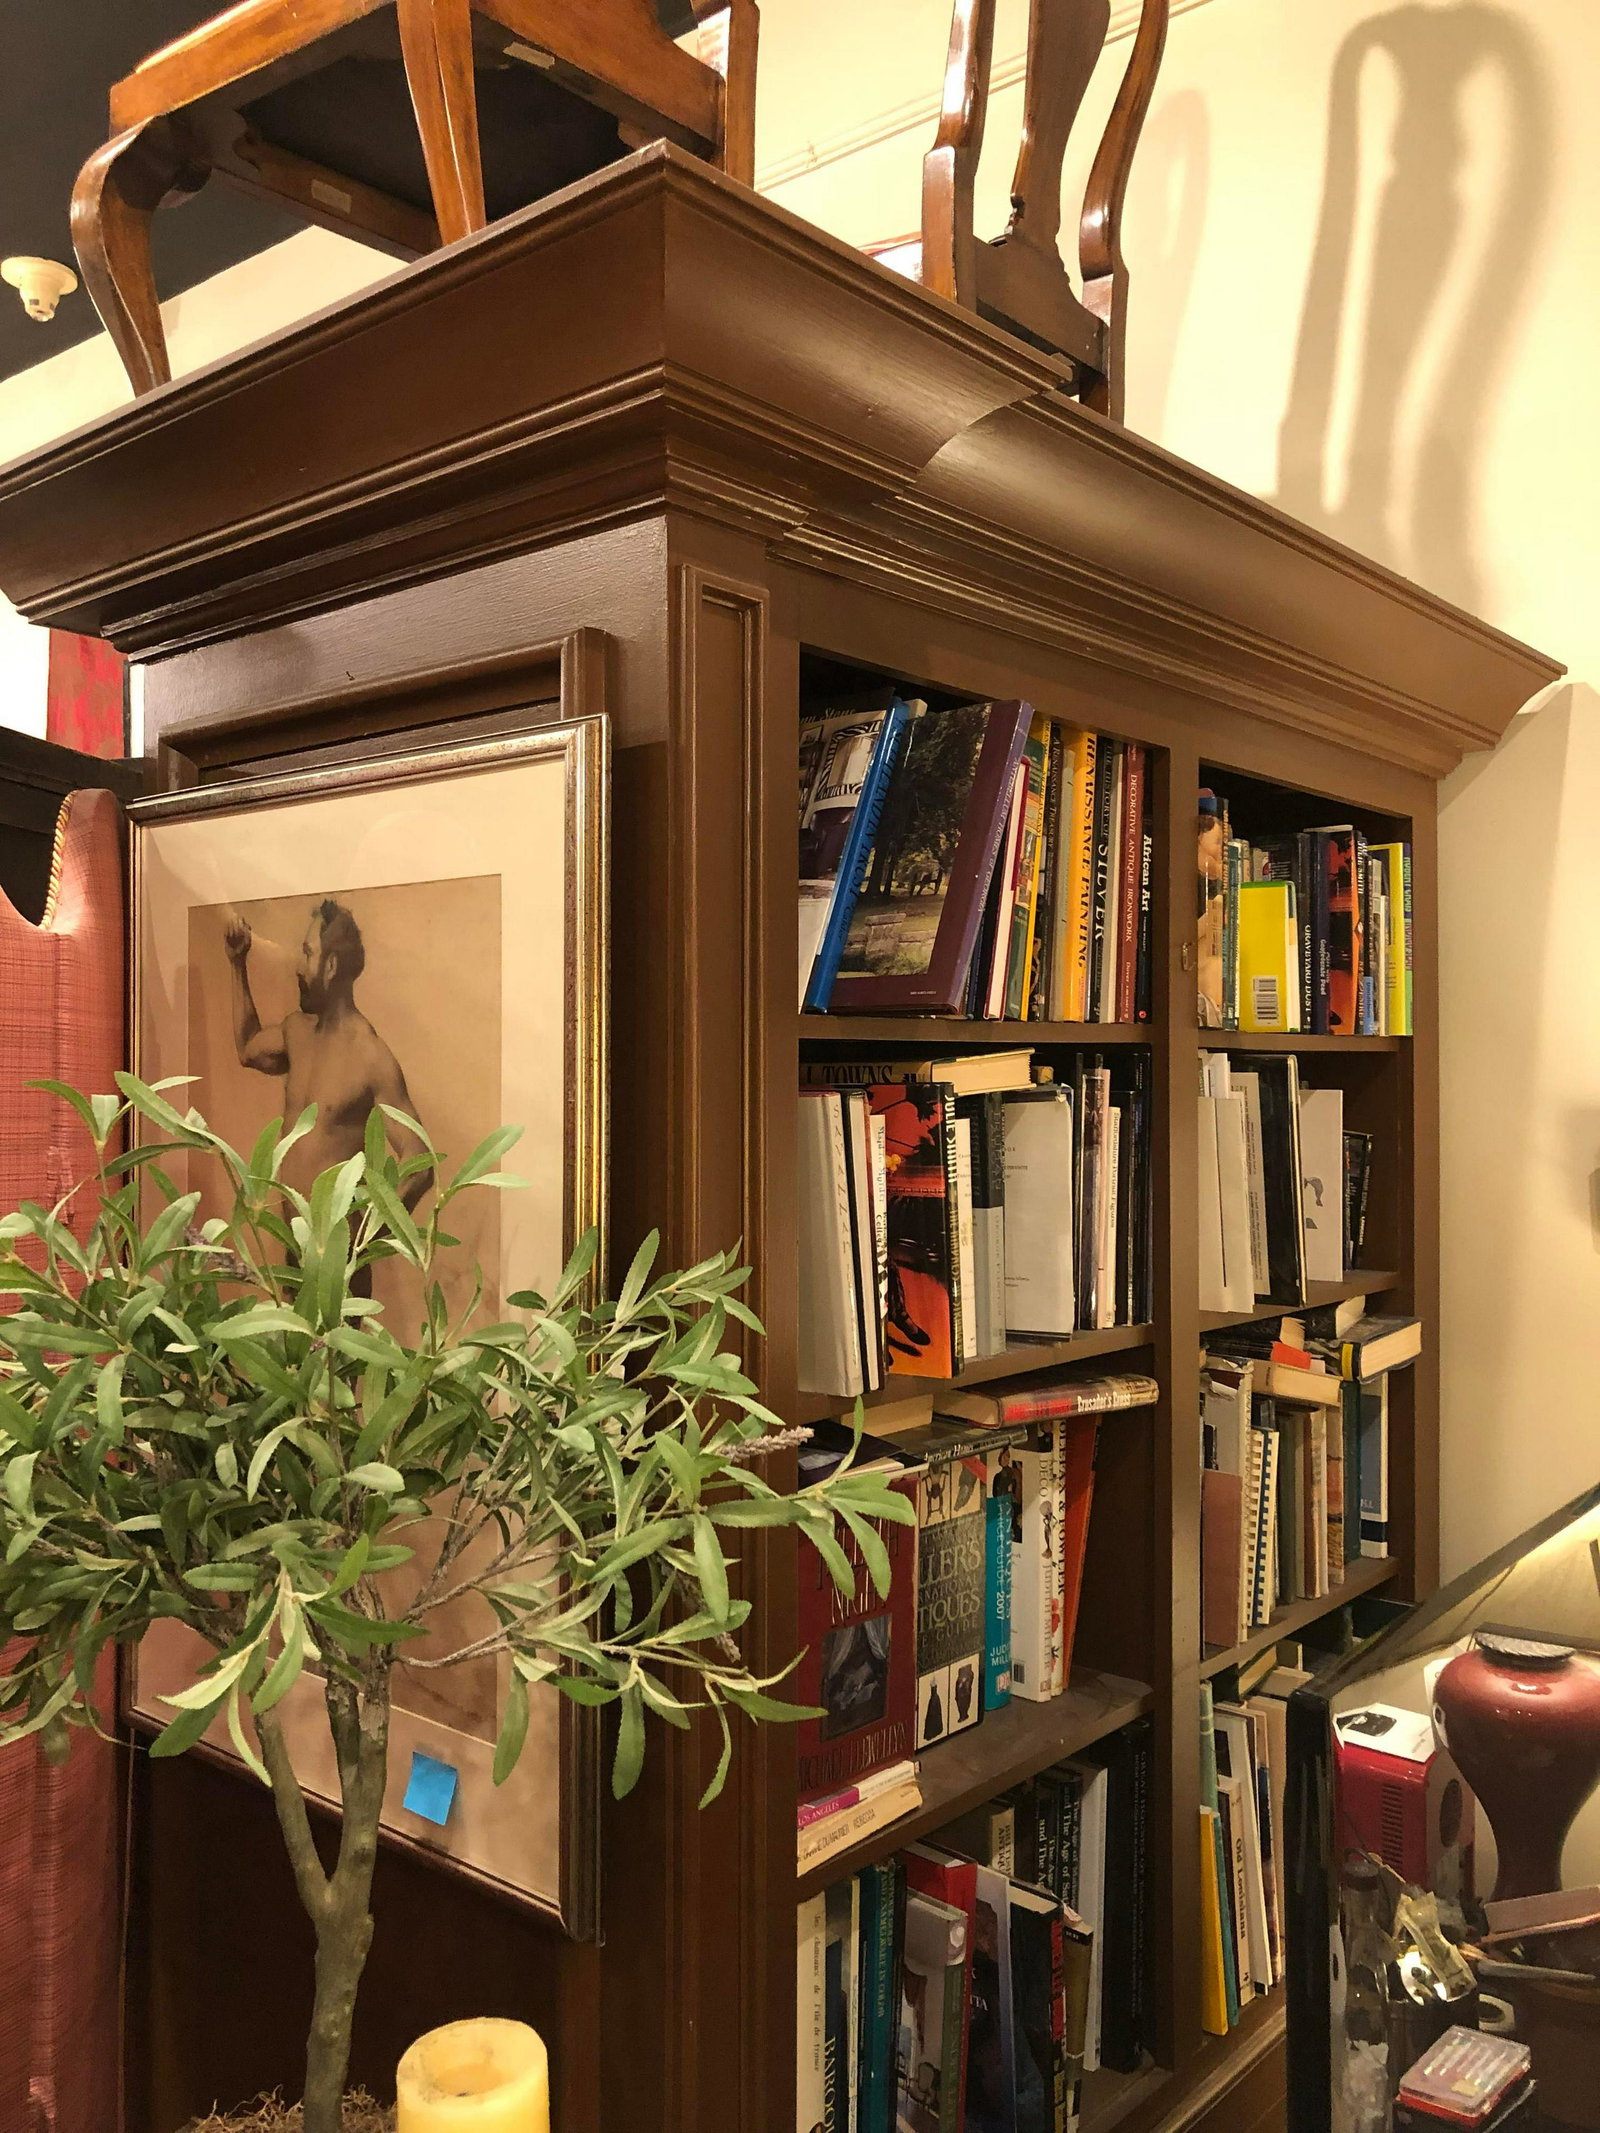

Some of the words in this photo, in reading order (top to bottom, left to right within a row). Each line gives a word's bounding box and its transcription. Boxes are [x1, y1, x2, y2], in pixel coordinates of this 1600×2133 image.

[1050, 746, 1060, 802] RENAISSANCE
[1082, 737, 1096, 871] RENAISSANCE
[1128, 773, 1138, 836] DECORATIVE
[1047, 806, 1057, 850] TREASURY
[1126, 839, 1135, 885] ANTIQUE
[1142, 833, 1153, 886] African
[1095, 843, 1109, 940] SILVER
[1141, 889, 1151, 912] Art
[1078, 876, 1091, 968] PAINTING
[1124, 888, 1135, 943] IRONWORK
[1304, 924, 1312, 985] GRAVEYARD
[1319, 938, 1327, 977] Confederate
[1304, 986, 1312, 1012] DUST
[822, 1064, 894, 1085] TOWNS
[944, 1094, 956, 1134] JULIE
[947, 1134, 958, 1183] SMITH
[1077, 1394, 1112, 1413] Crusader's
[1113, 1390, 1132, 1408] Cross
[996, 1503, 1005, 1542] PRICE
[1058, 1500, 1066, 1513] &
[996, 1549, 1005, 1588] GUIDE
[1057, 1518, 1066, 1596] FOWLER
[995, 1591, 1005, 1620] 2007
[1043, 1565, 1051, 1613] JUDITH
[936, 1616, 978, 1642] GUIDE
[798, 1813, 812, 1828] LOS
[811, 1800, 841, 1822] ANGELES
[1038, 1818, 1047, 1842] and
[1063, 1811, 1072, 1837] The
[1073, 1801, 1081, 1820] The
[1038, 1844, 1047, 1865] The
[1062, 1840, 1071, 1862] Age
[1072, 1825, 1081, 1845] Age
[1235, 1837, 1243, 1865] Old
[1062, 1865, 1071, 1879] of
[1236, 1867, 1246, 1940] Louisiana
